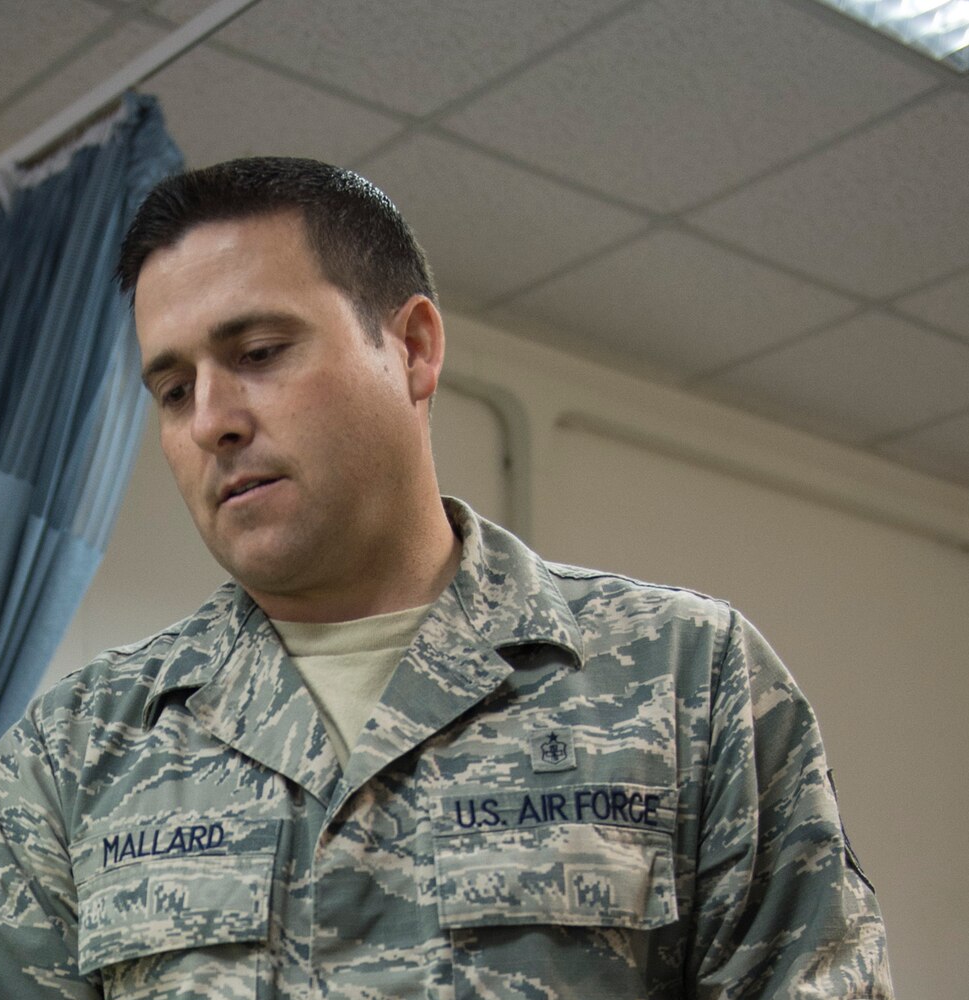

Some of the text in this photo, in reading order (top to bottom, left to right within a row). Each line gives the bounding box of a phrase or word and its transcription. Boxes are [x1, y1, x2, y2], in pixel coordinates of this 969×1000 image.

[455, 789, 659, 828] U.S. AIR FORCE
[102, 823, 226, 868] MALLARD
